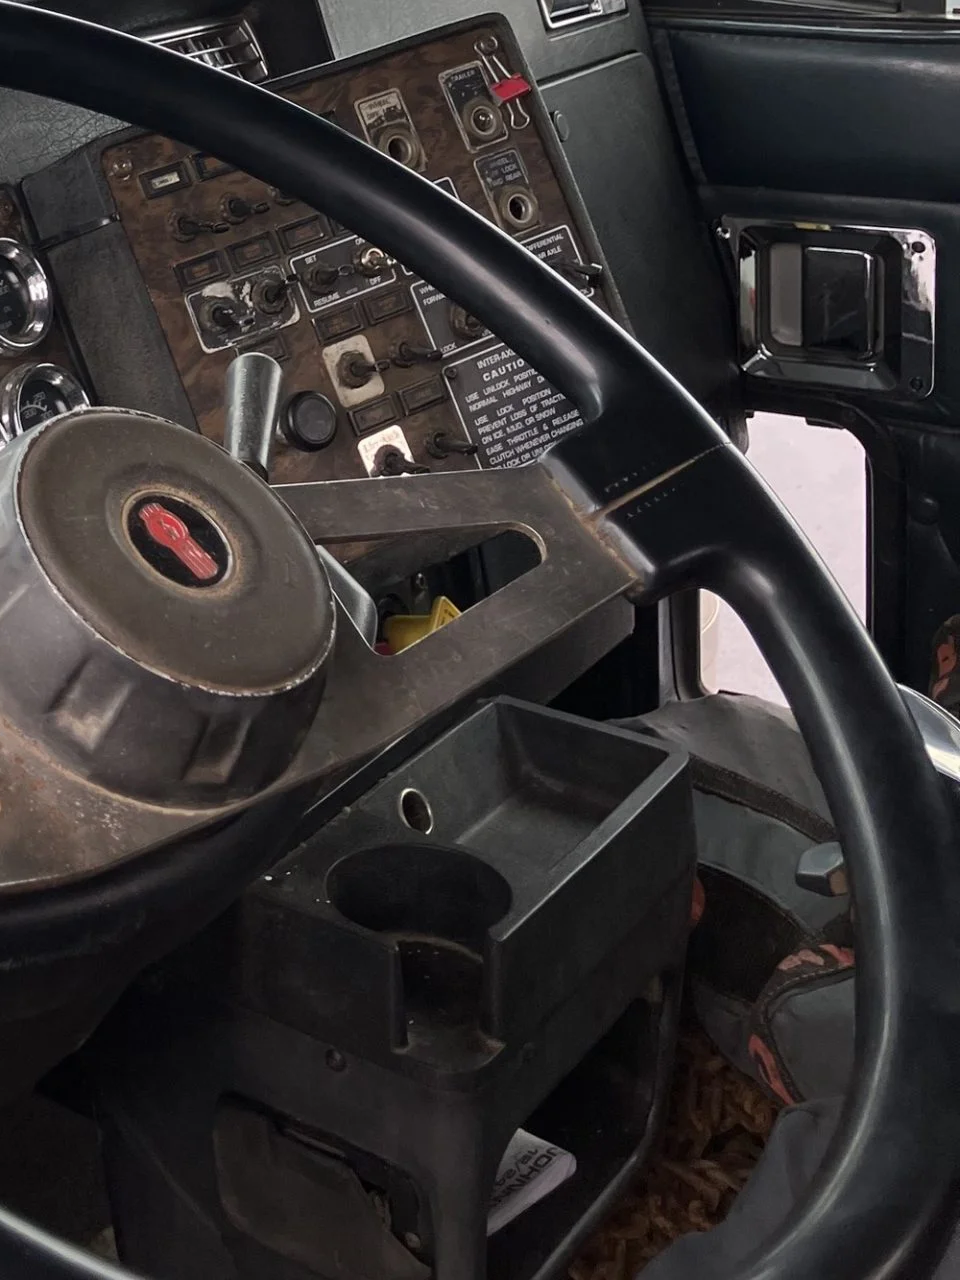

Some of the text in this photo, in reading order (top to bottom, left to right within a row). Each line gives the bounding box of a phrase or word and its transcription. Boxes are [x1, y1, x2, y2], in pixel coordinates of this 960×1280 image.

[304, 255, 317, 264] SET
[369, 275, 382, 285] OFF
[313, 292, 340, 307] RESUME
[423, 293, 446, 306] FORWA
[477, 348, 516, 369] INTER-AXL
[482, 358, 525, 382] CAUTIO
[465, 392, 480, 403] USE
[483, 379, 510, 396] UNLOCK
[513, 368, 538, 383] POSITI
[469, 380, 532, 412] NORMAL HIGHWAY
[474, 388, 552, 426] USE LOCK POSITION
[478, 393, 566, 435] PREVENT LOSS OF TRACTI
[481, 436, 492, 445] ON
[525, 416, 535, 426] OR
[535, 407, 556, 422] SNOW
[485, 443, 503, 456] EASE
[506, 427, 539, 446] THROTTLE
[552, 409, 580, 427] RELEASE
[489, 418, 584, 465] CLUTCH WHENEVER CHANGING
[503, 458, 521, 469] LOCK
[521, 452, 531, 462] OR
